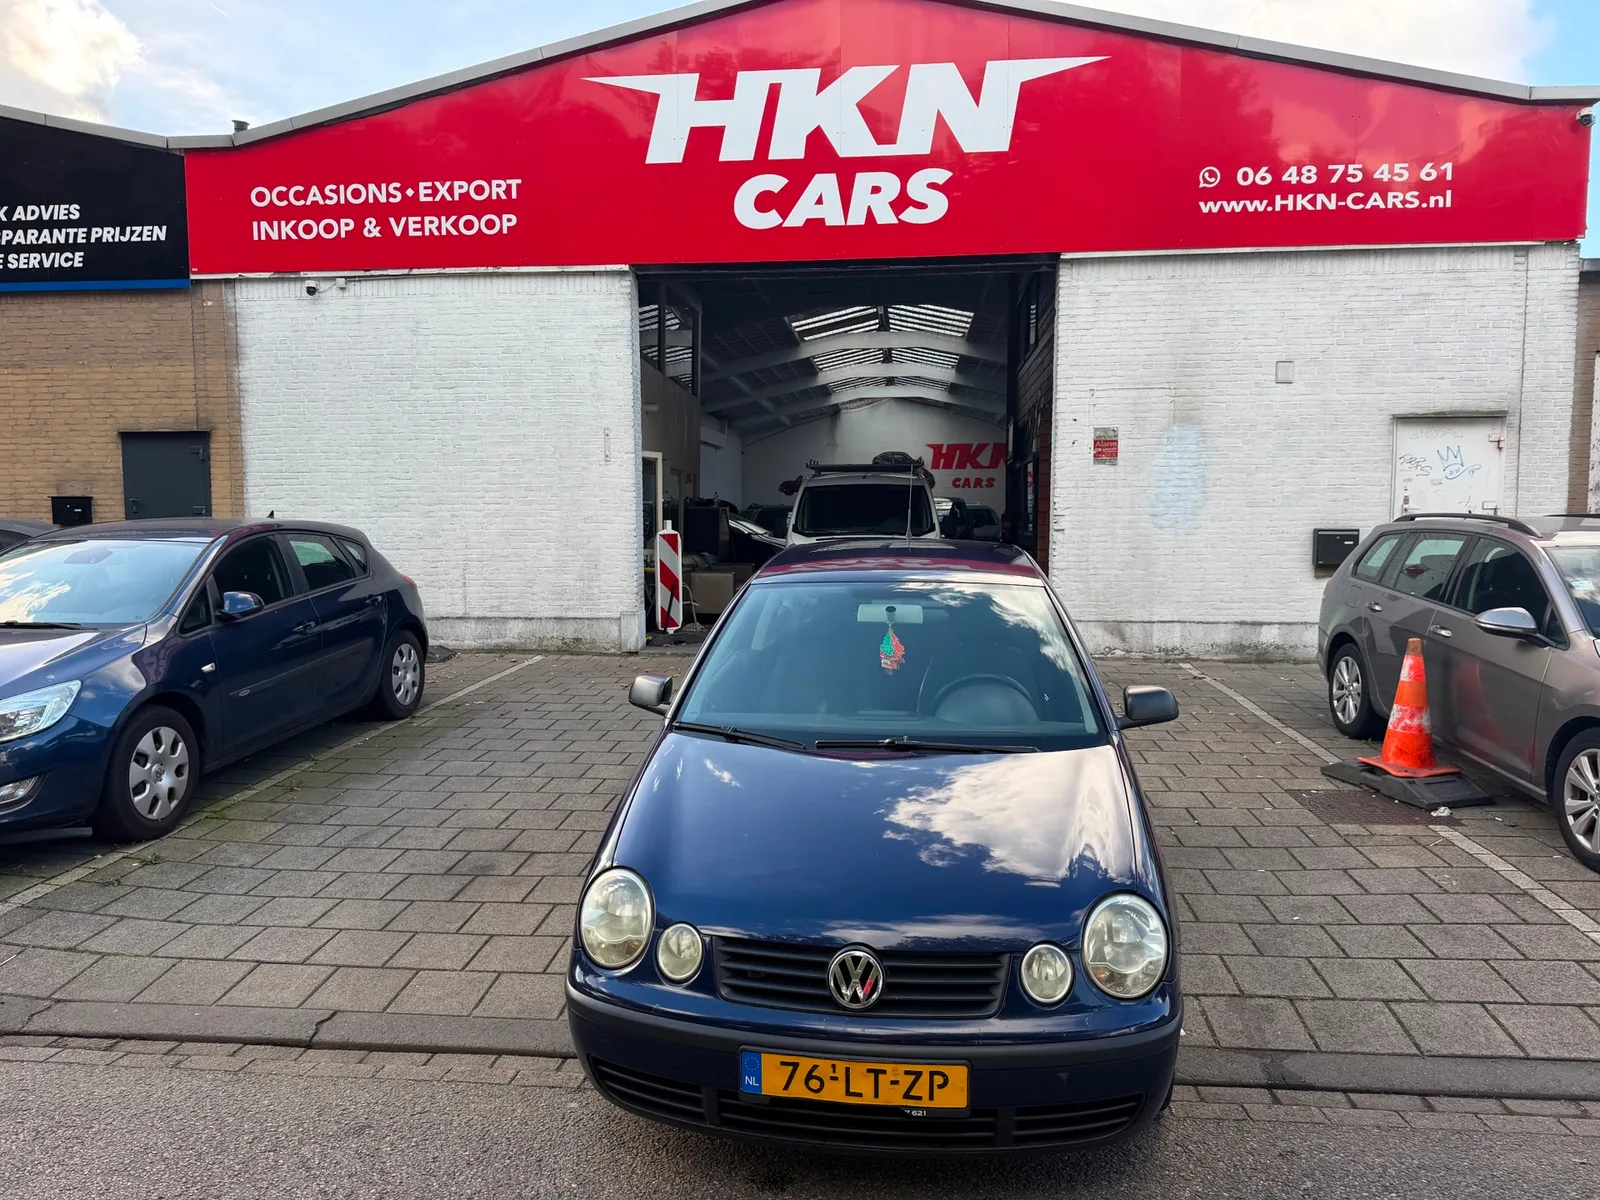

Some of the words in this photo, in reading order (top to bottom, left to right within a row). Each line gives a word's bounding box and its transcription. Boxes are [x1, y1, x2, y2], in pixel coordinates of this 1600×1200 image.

[580, 55, 1112, 164] HKN
[1237, 166, 1272, 186] 06
[1281, 165, 1318, 185] 48
[1328, 164, 1363, 183] 75
[1373, 162, 1409, 182] 45
[1419, 162, 1453, 181] 61
[250, 182, 402, 207] OCCASIONS
[419, 178, 522, 202] EXPORT
[733, 168, 953, 230] CARS
[1199, 189, 1452, 214] www.HKN-CARS.nl
[12, 204, 81, 221] ADVIES
[0, 228, 87, 245] PARANTE
[90, 225, 167, 243] PRIJZEN
[252, 219, 354, 241] INKOOP
[363, 218, 381, 239] &
[389, 213, 517, 237] VERKOOP
[7, 252, 85, 269] SERVICE
[952, 477, 996, 489] CARS
[745, 1075, 759, 1087] NL
